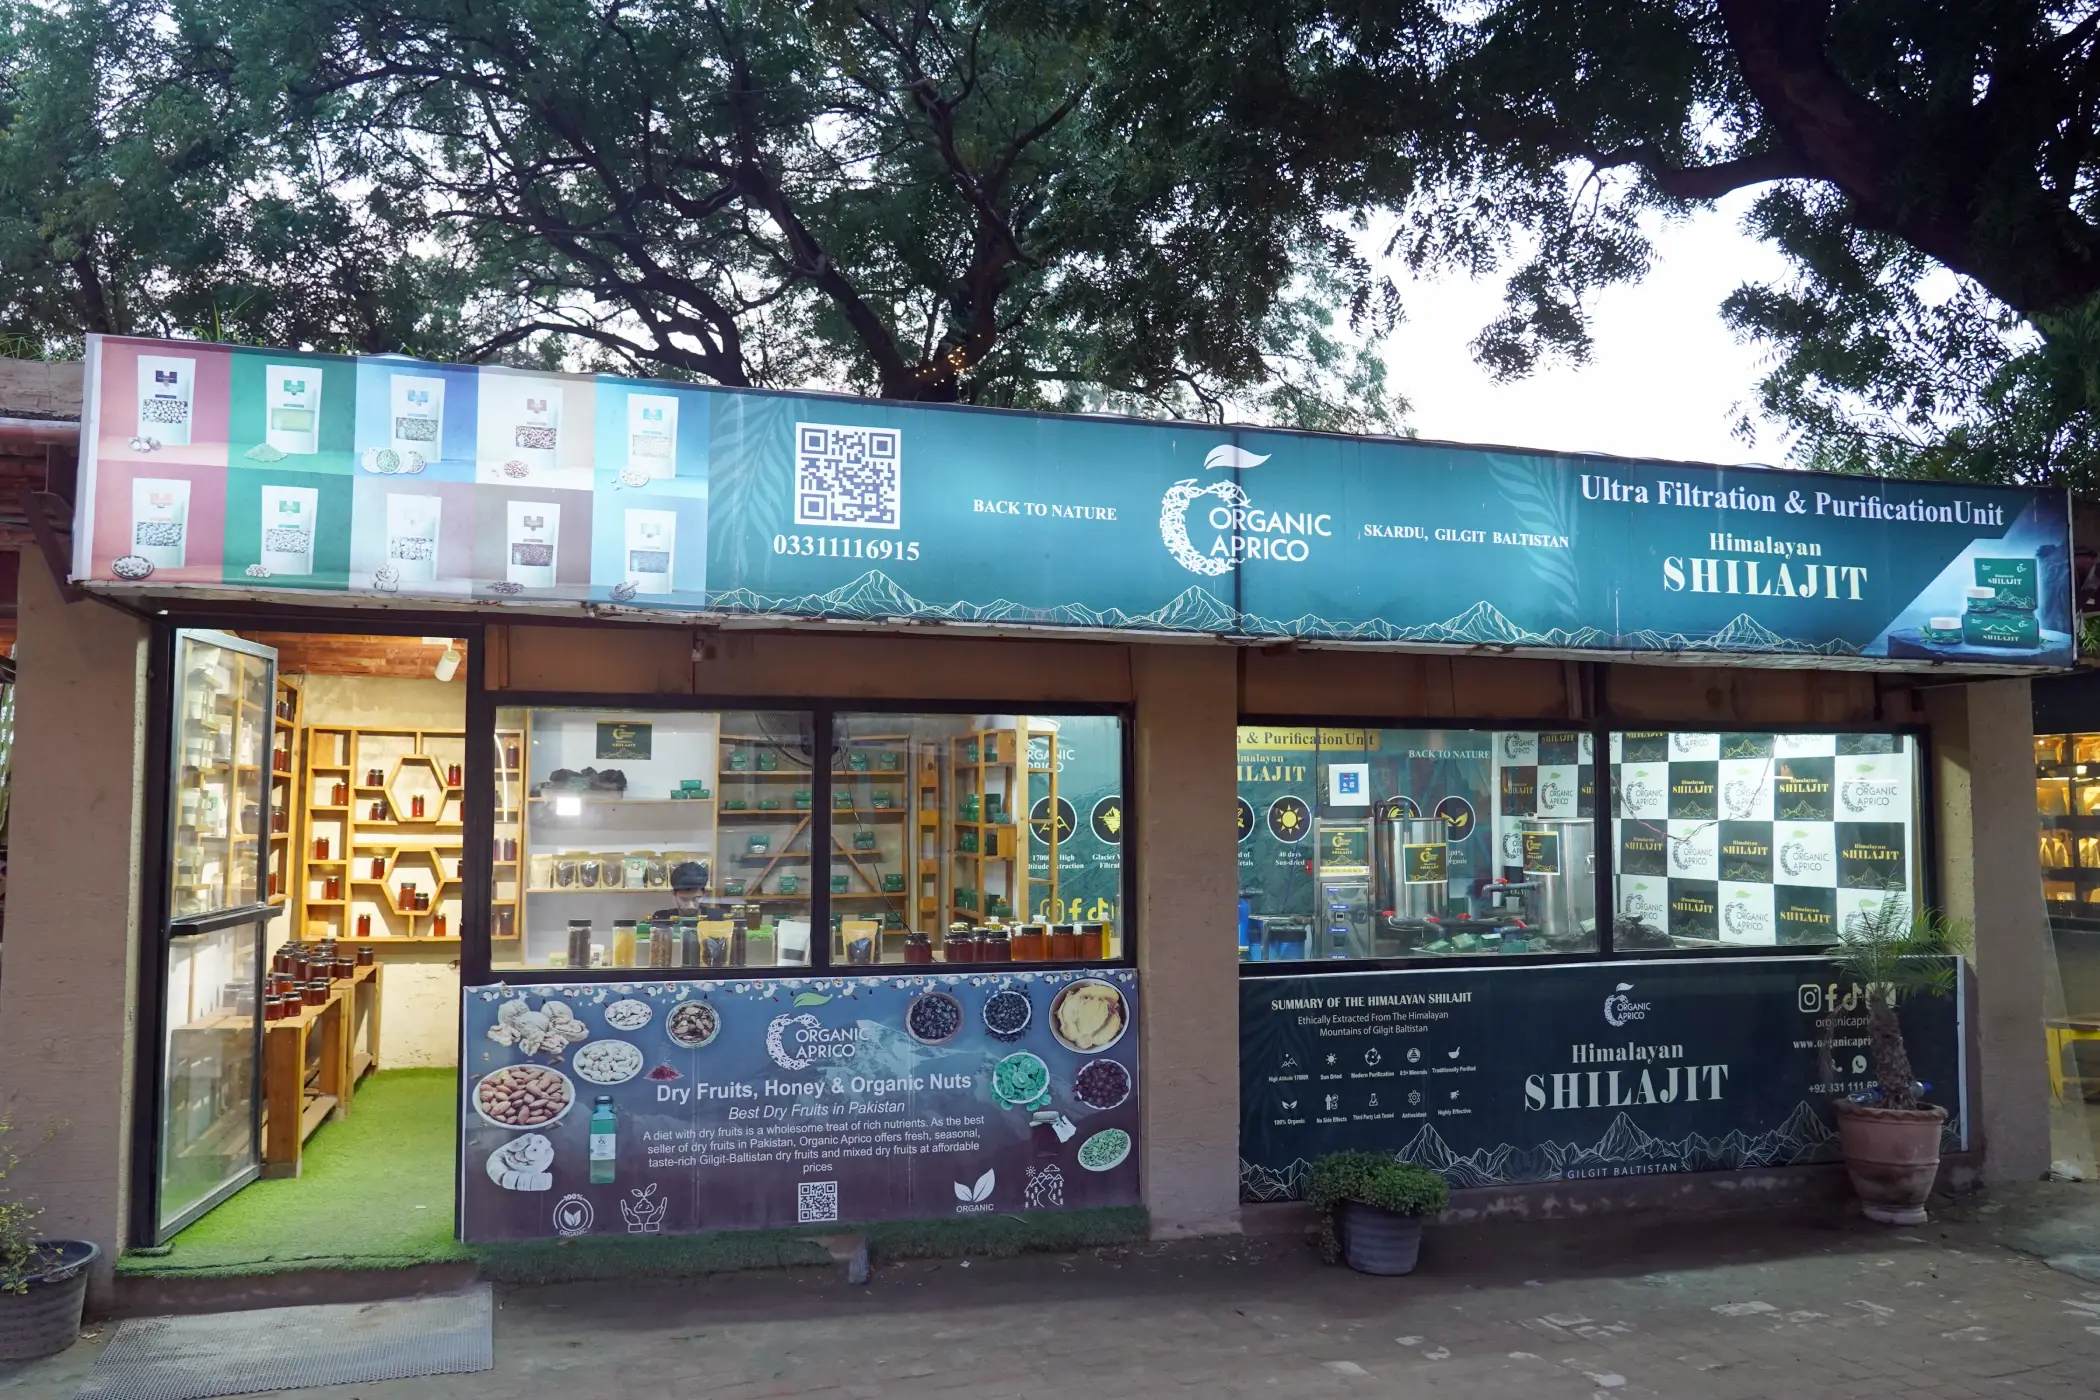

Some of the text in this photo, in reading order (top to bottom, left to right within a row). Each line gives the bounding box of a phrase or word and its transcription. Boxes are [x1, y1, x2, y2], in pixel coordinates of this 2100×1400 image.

[1580, 474, 1649, 504] Ultra
[1656, 480, 1777, 514] Filtration
[1784, 490, 1807, 515] &
[973, 499, 1117, 521] BACK TO NATURE
[1209, 507, 1332, 537] ORGANIC
[1364, 524, 1569, 549] SKARDU, GILGIT BALTISTAN
[773, 534, 920, 561] 03311116915
[1209, 534, 1310, 562] APRICO
[1710, 532, 1822, 560] Himalayan
[1663, 556, 1868, 601] SHILAJIT
[1247, 732, 1258, 744] &
[1264, 732, 1343, 745] Purificaion
[1345, 733, 1374, 745] Unt
[1685, 739, 1709, 747] APRICO
[1409, 750, 1490, 759] BACK TO NATURE
[1237, 766, 1306, 782] ILAJIT
[1549, 789, 1574, 798] ORGANIC
[1672, 785, 1714, 794] SHILAJIT
[1779, 783, 1829, 793] SHILAJIT
[1856, 787, 1898, 796] ORGANIC
[1636, 798, 1658, 806] APRICO
[1857, 797, 1890, 806] APRICO
[1625, 842, 1663, 851] SHILAJIT
[1684, 848, 1713, 856] ORGANIC
[1723, 846, 1768, 856] SHILAJIT
[1059, 854, 1075, 862] High
[1092, 853, 1116, 861] Glacier
[1792, 852, 1829, 862] ORGANIC
[1842, 849, 1899, 860] SHILAJIT
[1684, 857, 1707, 866] APRICO
[1793, 862, 1822, 871] APRICO
[1635, 902, 1663, 911] ORGANIC
[1672, 902, 1714, 914] SHILAJIT
[1736, 913, 1769, 922] ORGANIC
[1780, 912, 1831, 924] SHILAJIT
[1737, 922, 1763, 931] APRICO
[1271, 992, 1472, 1011] SUMMARY OF THE HIMALAYAN SHILAJIT
[1617, 1002, 1650, 1011] ORGANIC
[1298, 1011, 1449, 1025] Ethically Extracted From The Himalayan
[1617, 1011, 1645, 1020] APRICO
[795, 1027, 869, 1043] ORGANIC
[1319, 1024, 1428, 1037] Mountains of Gilgit Baltistan
[795, 1043, 856, 1059] APRICO
[1572, 1042, 1684, 1064] Himalayan
[656, 1073, 972, 1105] Dry Fruits, Honey & Organic Nuts
[1524, 1064, 1729, 1112] SHILAJIT
[1809, 1084, 1826, 1094] +92
[728, 1101, 905, 1121] Best Dry Fruits in Pakistan
[643, 1115, 984, 1141] A diet with dry fruits is a wholesome treat of rich nutrients. As the best
[648, 1128, 981, 1155] seller of dry fruits in Pakistan, Organic Aprico offers fresh, seasonal,
[649, 1141, 979, 1168] taste-rich Gilgit-Baltistan dry fruits and mixed dry fruits at affordable
[803, 1162, 832, 1175] prices
[1567, 1162, 1677, 1179] GILGIT BALTISTAN
[563, 1193, 584, 1202] 100%
[956, 1204, 994, 1213] ORGANIC
[559, 1228, 587, 1237] ORGANIC
